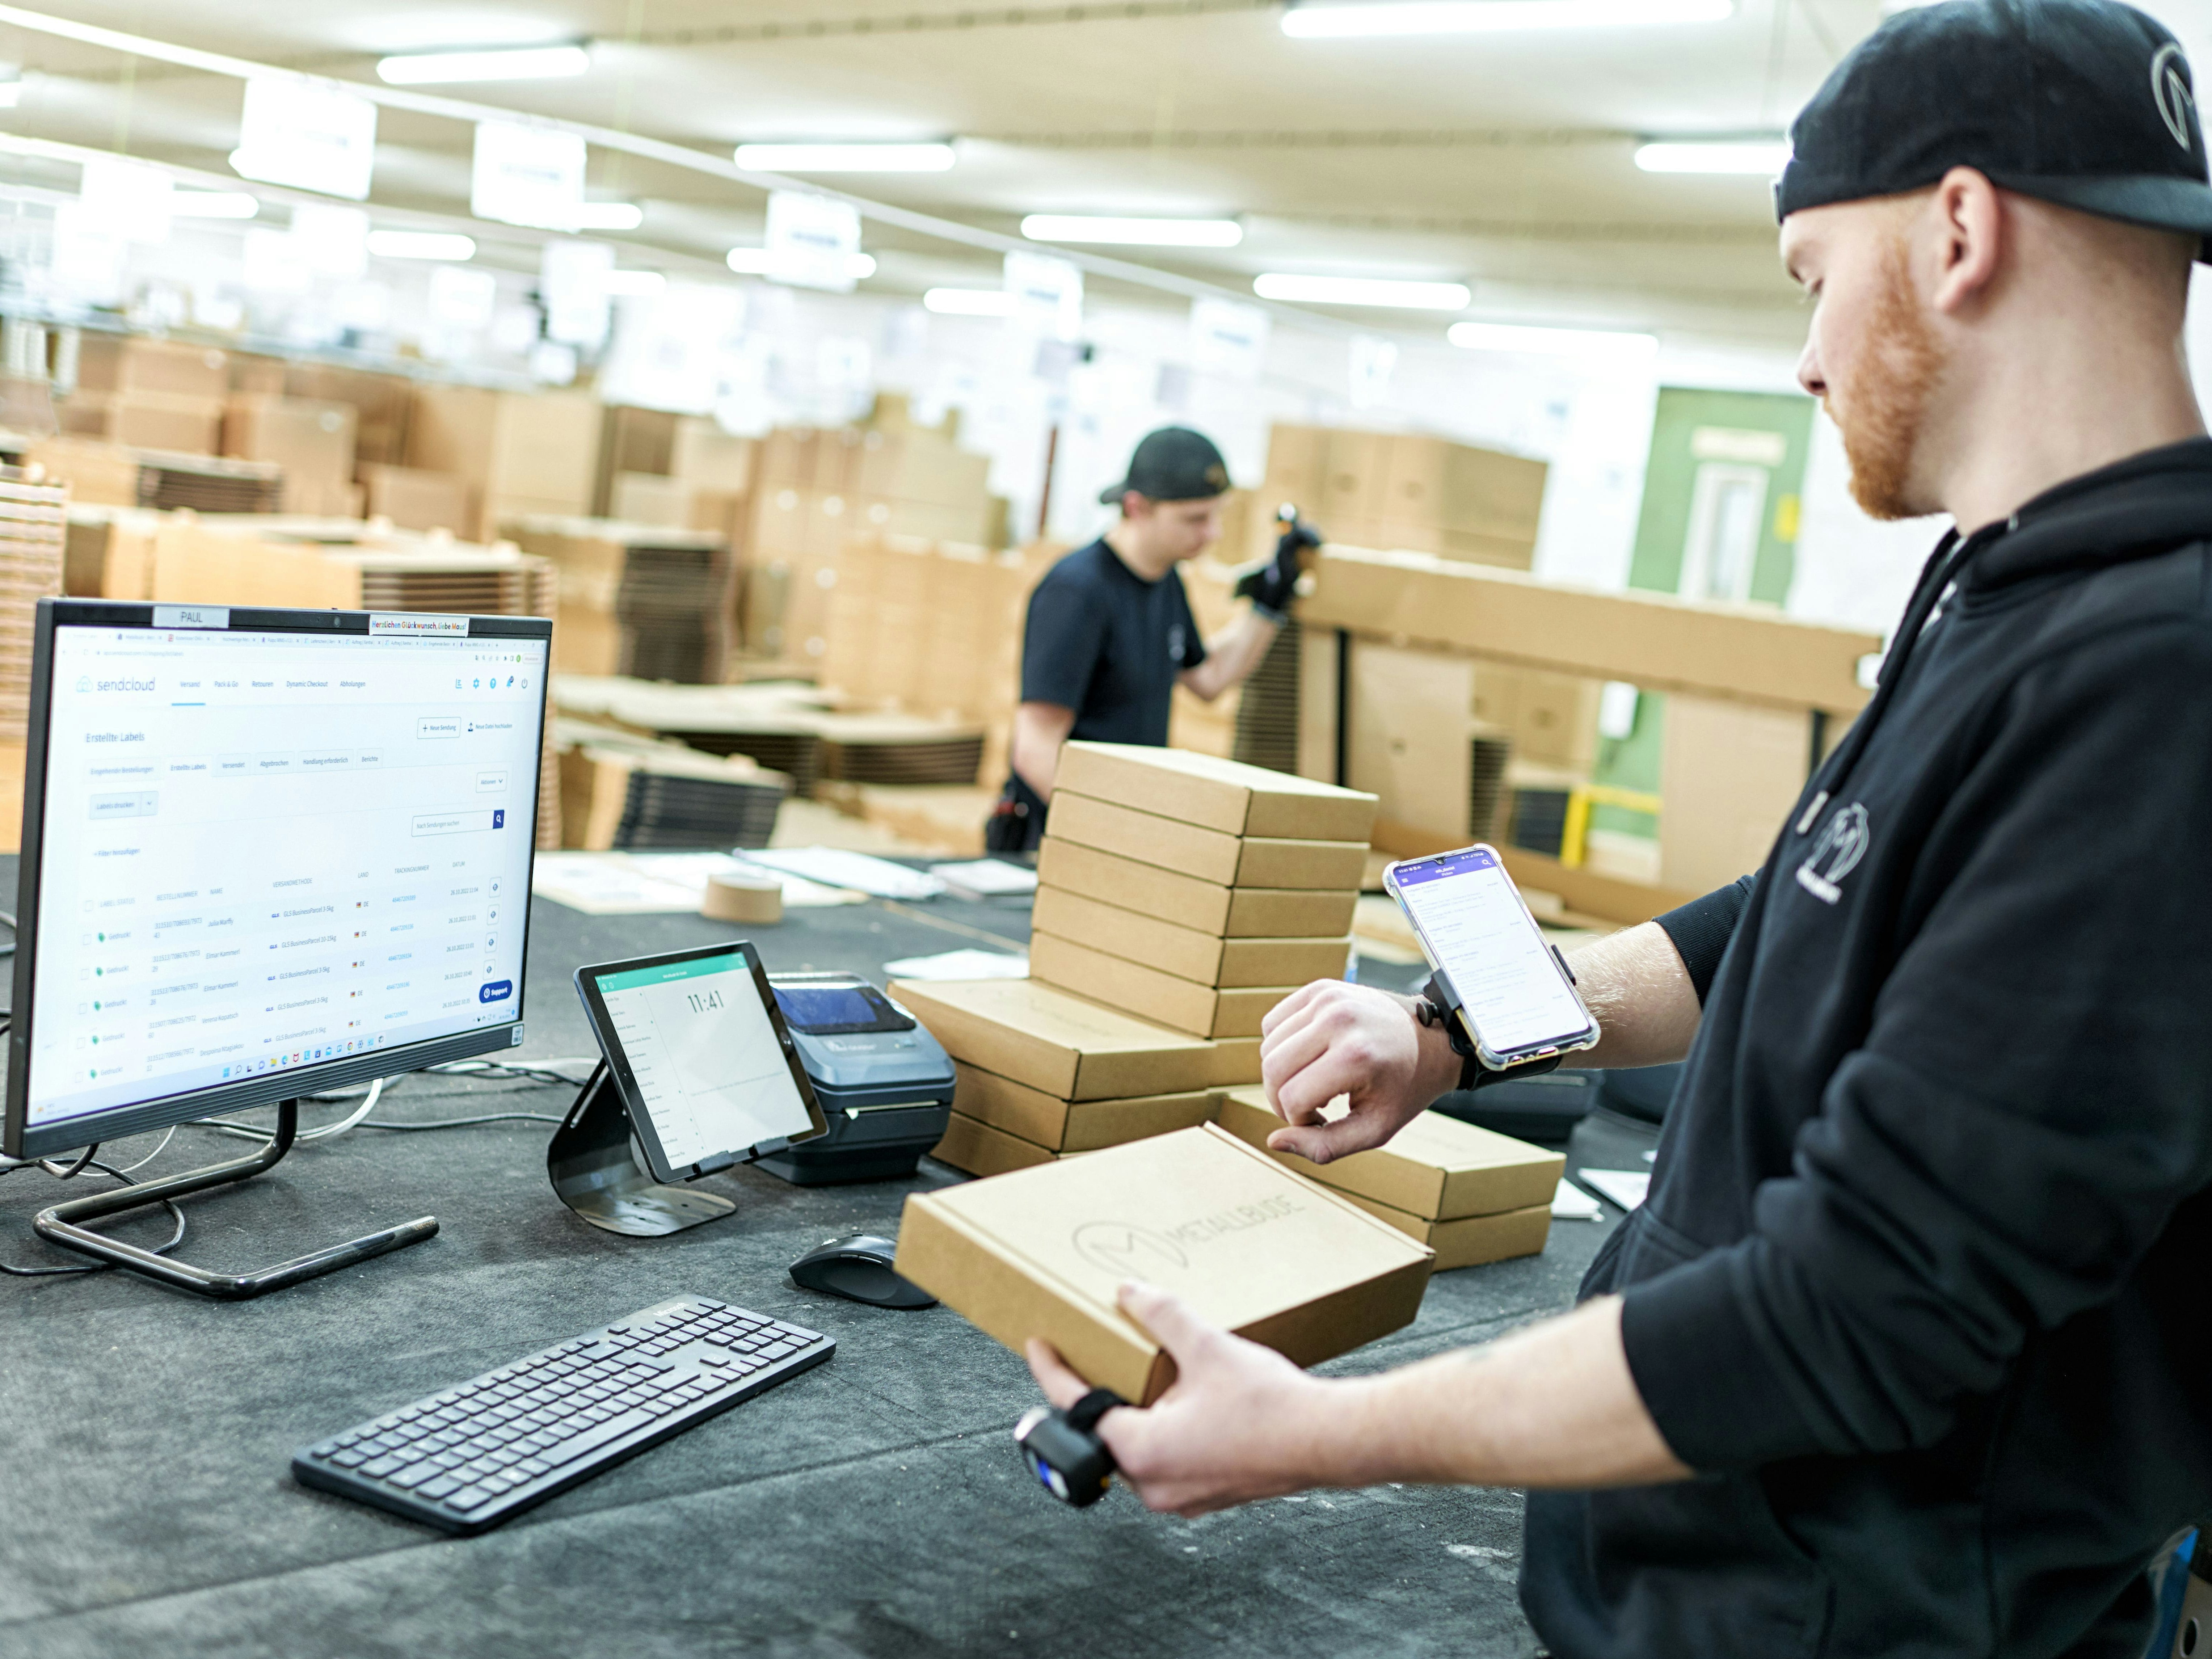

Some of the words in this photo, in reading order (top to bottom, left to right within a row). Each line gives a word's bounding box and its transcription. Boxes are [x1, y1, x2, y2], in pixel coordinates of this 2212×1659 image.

[181, 612, 203, 623] PAUL
[401, 621, 438, 630] Glückwunsch,
[97, 677, 155, 691] sendcloud
[86, 733, 118, 742] Erstellte
[121, 732, 145, 741] Labels
[90, 767, 121, 776] Eingehende
[395, 865, 429, 873] TRACKINGNUMMER
[273, 878, 313, 888] VERSANDMETHODE
[157, 891, 198, 901] BESTELLNUMMER
[392, 894, 416, 903] 48467209389
[100, 899, 115, 908] LABEL
[292, 906, 322, 916] BusinessParcel
[109, 932, 131, 940] Gedruckt
[291, 938, 320, 947] BusinessParcel
[220, 948, 240, 957] Kammerl
[107, 965, 129, 974] Gedruckt
[288, 968, 318, 978] BusinessParcel
[218, 981, 238, 989] Kammerl
[491, 987, 508, 996] Support
[105, 999, 127, 1008] Gedruckt
[287, 998, 316, 1009] BusinessParcel
[688, 990, 724, 1013] 11:41
[218, 1012, 239, 1021] Kopatsch
[103, 1033, 125, 1042] Gedruckt
[285, 1029, 314, 1040] BusinessParcel
[200, 1048, 221, 1056] Despoina
[222, 1043, 244, 1052] Ntagiakou
[101, 1066, 123, 1076] Gedruckt
[1164, 1194, 1306, 1243] METALLBUDE
[653, 1302, 690, 1317] Microsoft
